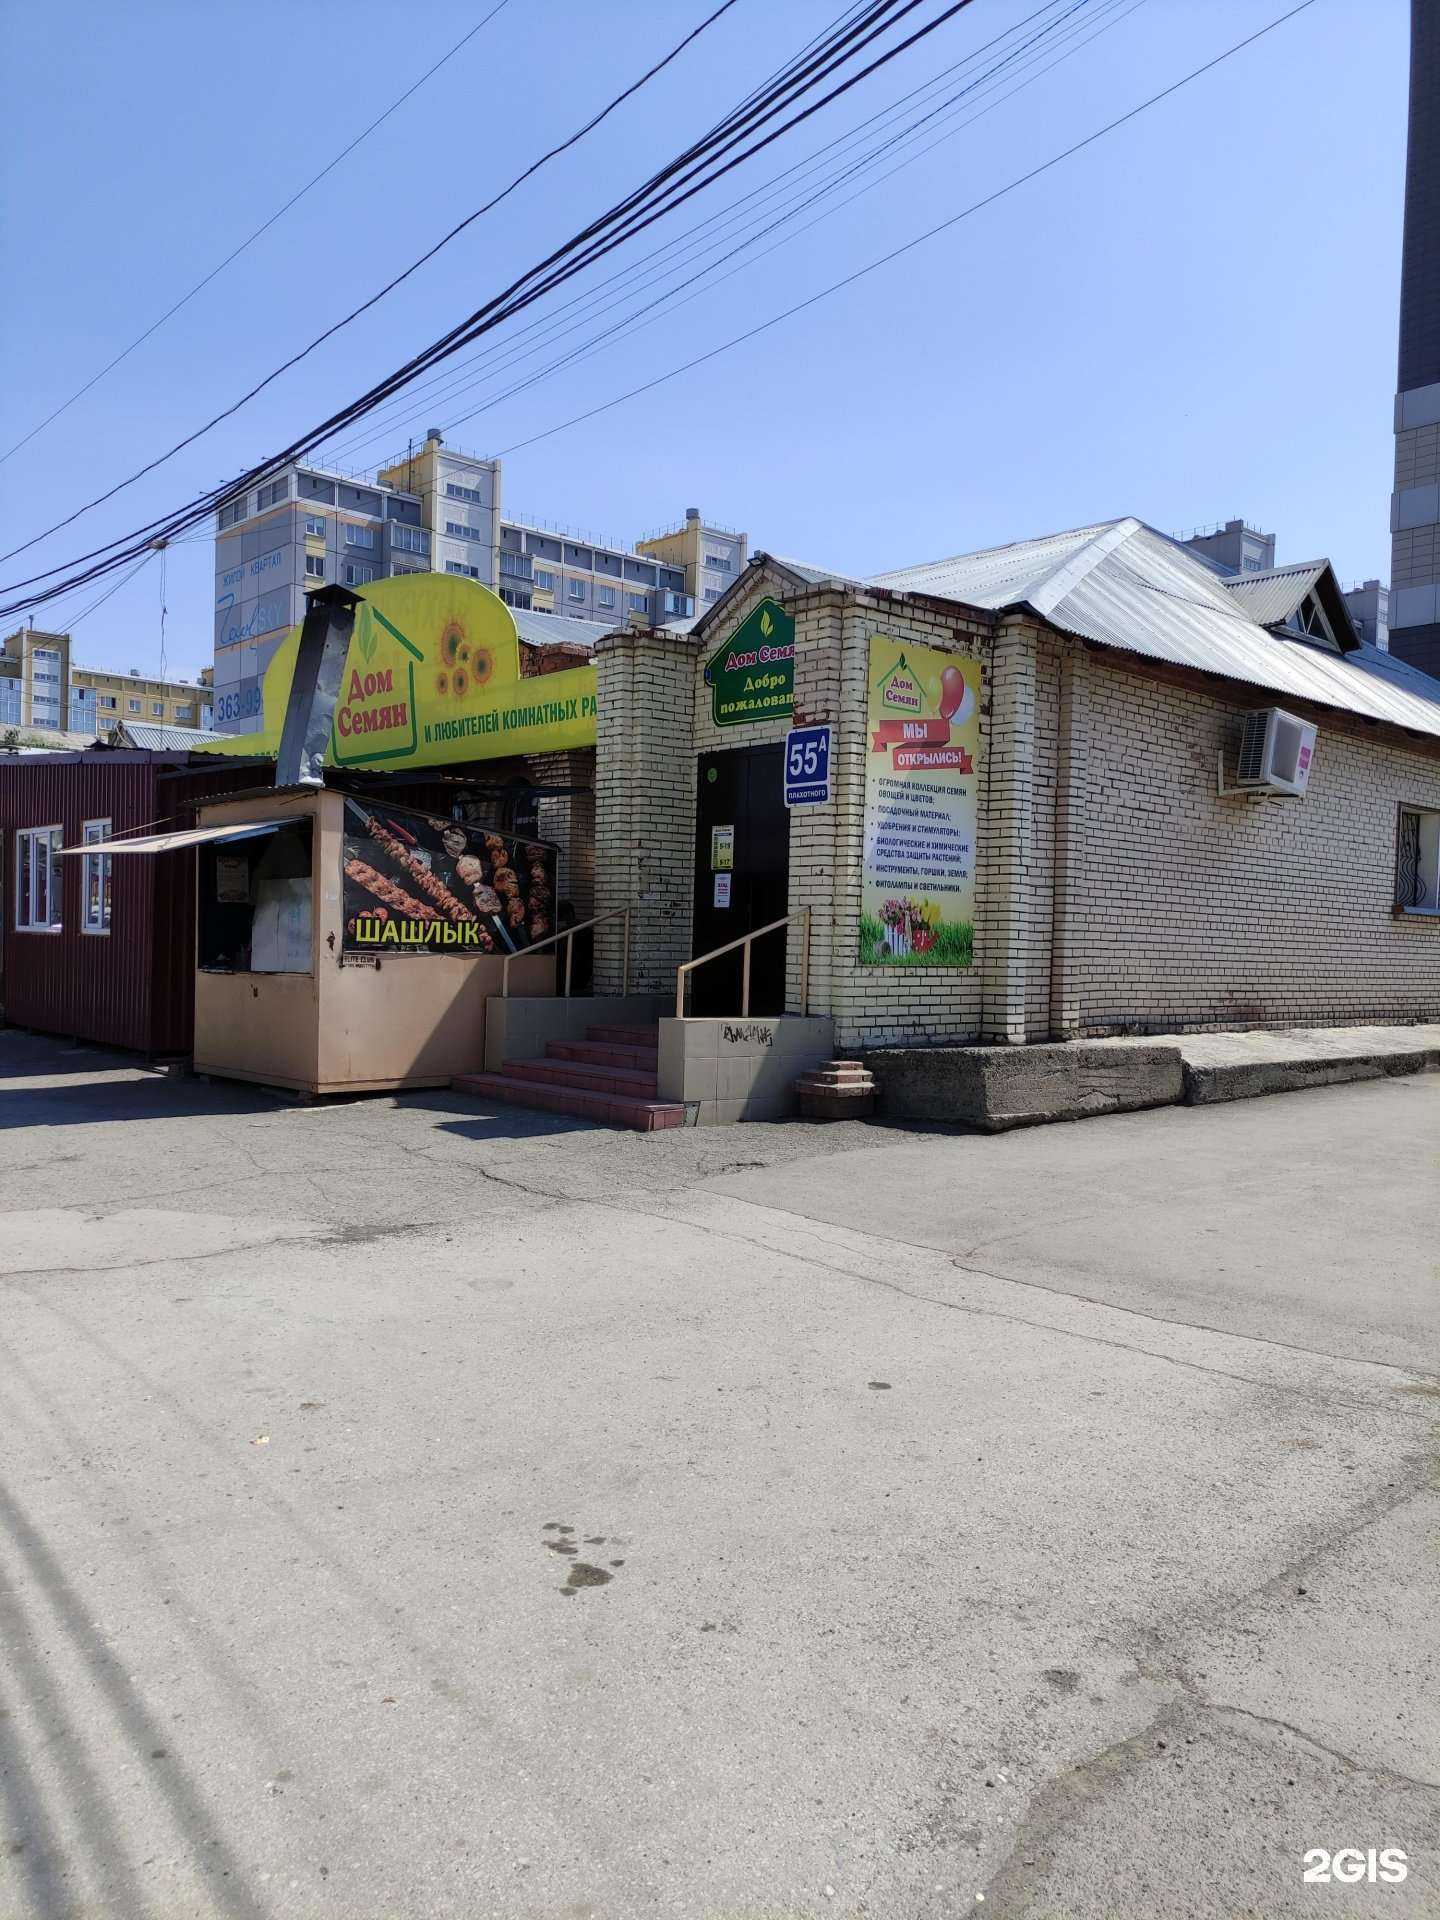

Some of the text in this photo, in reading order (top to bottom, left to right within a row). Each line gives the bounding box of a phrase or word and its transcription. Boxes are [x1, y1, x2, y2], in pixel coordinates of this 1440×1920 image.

[725, 652, 757, 672] Дом
[348, 669, 393, 705] Дом
[743, 673, 786, 693] Добро
[891, 676, 913, 690] Дом
[886, 690, 918, 706] Семян
[338, 703, 408, 737] Семян
[424, 725, 432, 743] И
[434, 709, 499, 742] ЛЮБИТЕЛЕЙ
[503, 699, 578, 730] КОМНАТНЫХ
[903, 723, 928, 739] МЫ
[897, 752, 962, 765] ОТКРЫЛИСЬ!
[788, 789, 826, 799] ПЛАХОТНОГО
[879, 778, 967, 796] ОГРОМНАЯ КОЛЛЕКЦИЯ СЕМЯН
[879, 790, 905, 800] ОВОЩЕЙ
[878, 805, 919, 817] ПОСАДОЧНЫЙ
[877, 821, 911, 832] УДОБРЕНИЯ
[877, 837, 925, 848] БИОЛОГИЧЕСКИЕ
[931, 842, 969, 852] ХИМИЧЕСКИЕ
[877, 849, 905, 858] СРЕДСТВА
[906, 851, 931, 861] ЗАЩИТЫ
[876, 880, 913, 890] ФИТОЛАМПЫ
[356, 919, 479, 943] ШАШЛЫК
